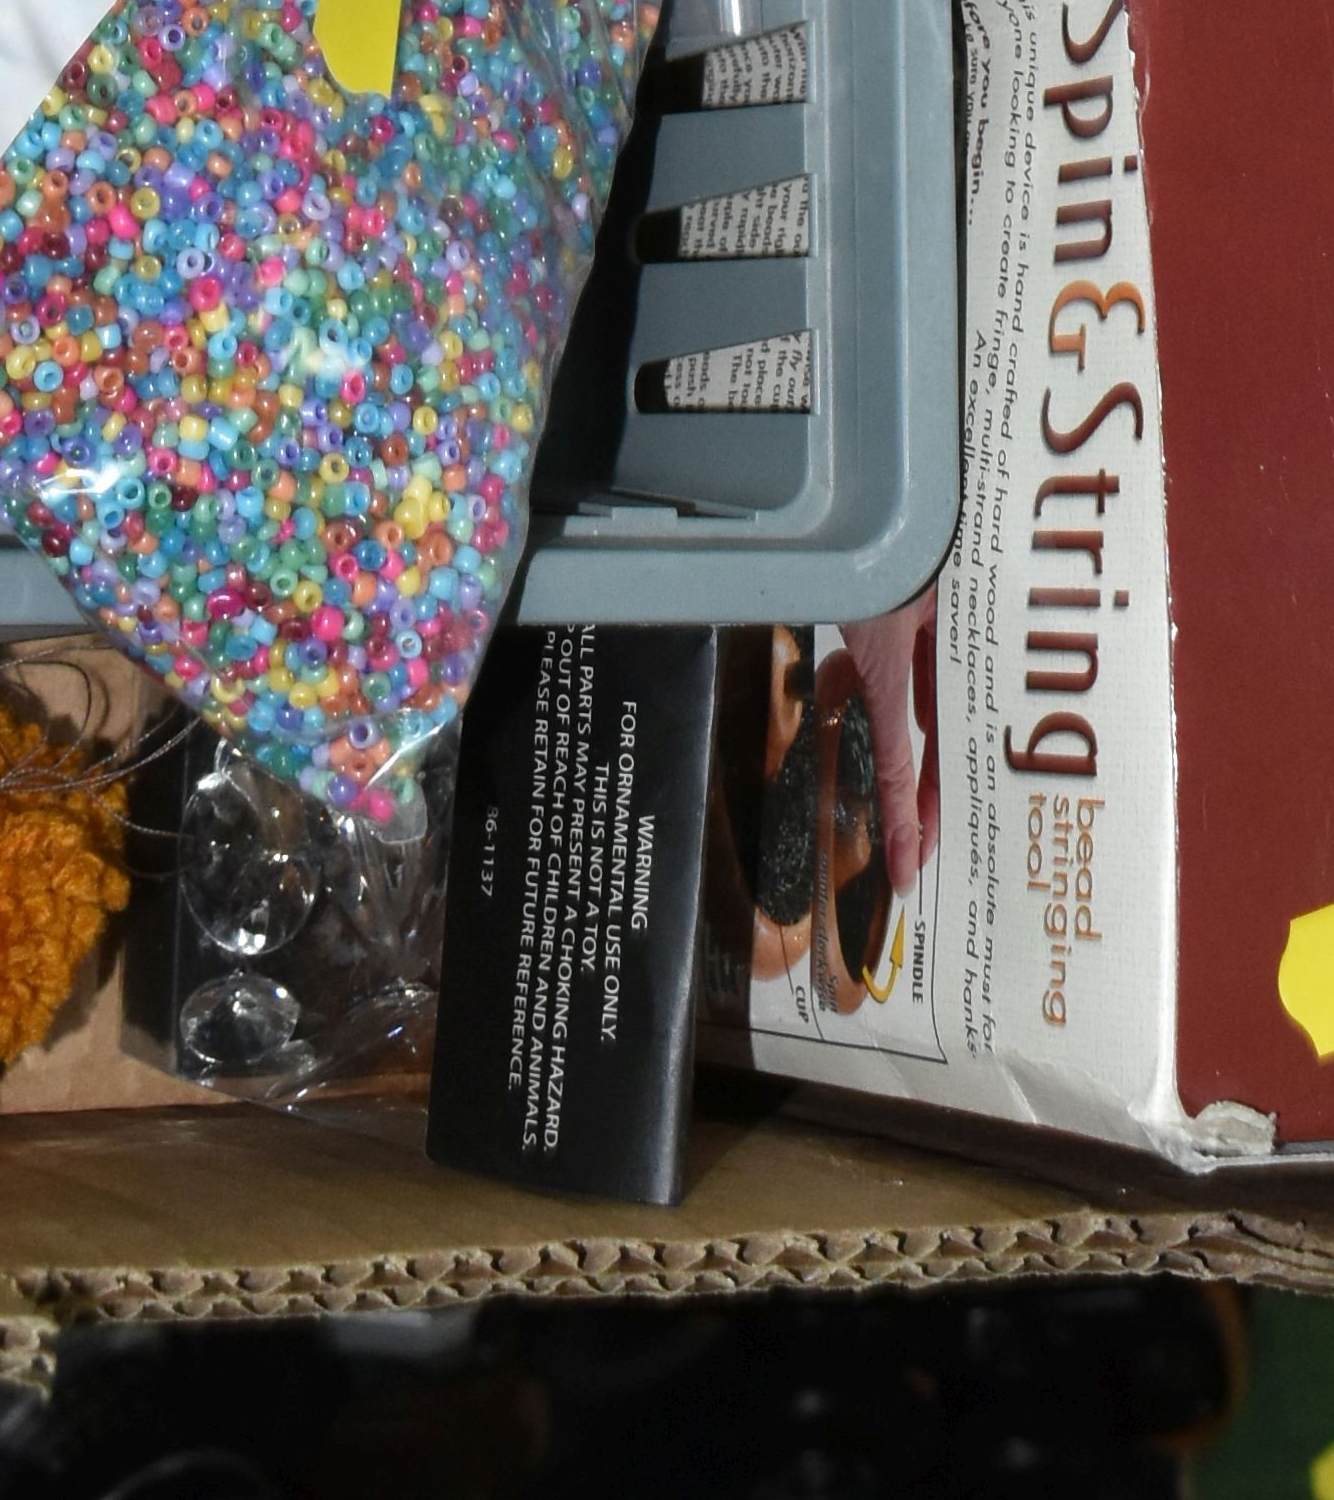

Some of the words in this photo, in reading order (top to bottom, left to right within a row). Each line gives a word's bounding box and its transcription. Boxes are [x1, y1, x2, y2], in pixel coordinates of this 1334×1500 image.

[980, 58, 991, 109] you
[1024, 31, 1039, 122] unique
[1004, 70, 1025, 168] looking
[1005, 180, 1016, 204] to
[1020, 131, 1037, 221] device
[997, 214, 1012, 299] create
[1018, 232, 1031, 252] is
[1011, 262, 1030, 333] hand
[972, 329, 987, 368] An
[985, 309, 1009, 395] fringe,
[1000, 342, 1018, 441] crafted
[971, 408, 994, 568] multi-strand
[996, 449, 1010, 480] of
[990, 487, 1008, 554] hard
[949, 577, 962, 665] saver!
[985, 564, 999, 646] wood
[535, 630, 556, 712] PLEASE
[557, 638, 573, 690] OUT
[965, 577, 981, 723] necklaces,
[985, 655, 999, 714] and
[556, 694, 571, 725] OF
[577, 665, 594, 735] PARTS
[620, 701, 637, 748] FOR
[985, 723, 995, 743] is
[532, 719, 549, 798] RETAIN
[552, 731, 570, 809] REACH
[574, 741, 590, 792] MAY
[592, 762, 610, 813] THIS
[986, 754, 996, 791] an
[528, 805, 544, 851] FOR
[550, 815, 564, 846] OF
[591, 820, 605, 839] IS
[607, 753, 635, 917] ORNAMENTAL
[965, 736, 984, 886] appliqués,
[1026, 794, 1052, 890] tool
[567, 798, 585, 900] PRESENT
[588, 846, 604, 897] NOT
[631, 815, 655, 929] WARNING
[986, 802, 1001, 926] absolute
[1074, 798, 1106, 941] bead
[520, 857, 541, 947] FUTURE
[538, 852, 562, 971] CHILDREN
[564, 905, 578, 921] A
[585, 901, 600, 917] A
[966, 900, 980, 959] and
[1042, 794, 1074, 1027] stringing
[580, 923, 598, 971] TOY.
[605, 924, 621, 969] USE
[912, 921, 926, 1003] SPINDLE
[981, 936, 993, 1004] must
[532, 977, 549, 1031] AND
[552, 927, 576, 1039] CHOKING
[600, 975, 620, 1041] ONLY.
[795, 985, 808, 1023] CUP
[508, 953, 532, 1090] REFERENCE.
[982, 1012, 995, 1053] for
[523, 1036, 544, 1145] ANIMALS.
[544, 1045, 566, 1148] HAZARD.
